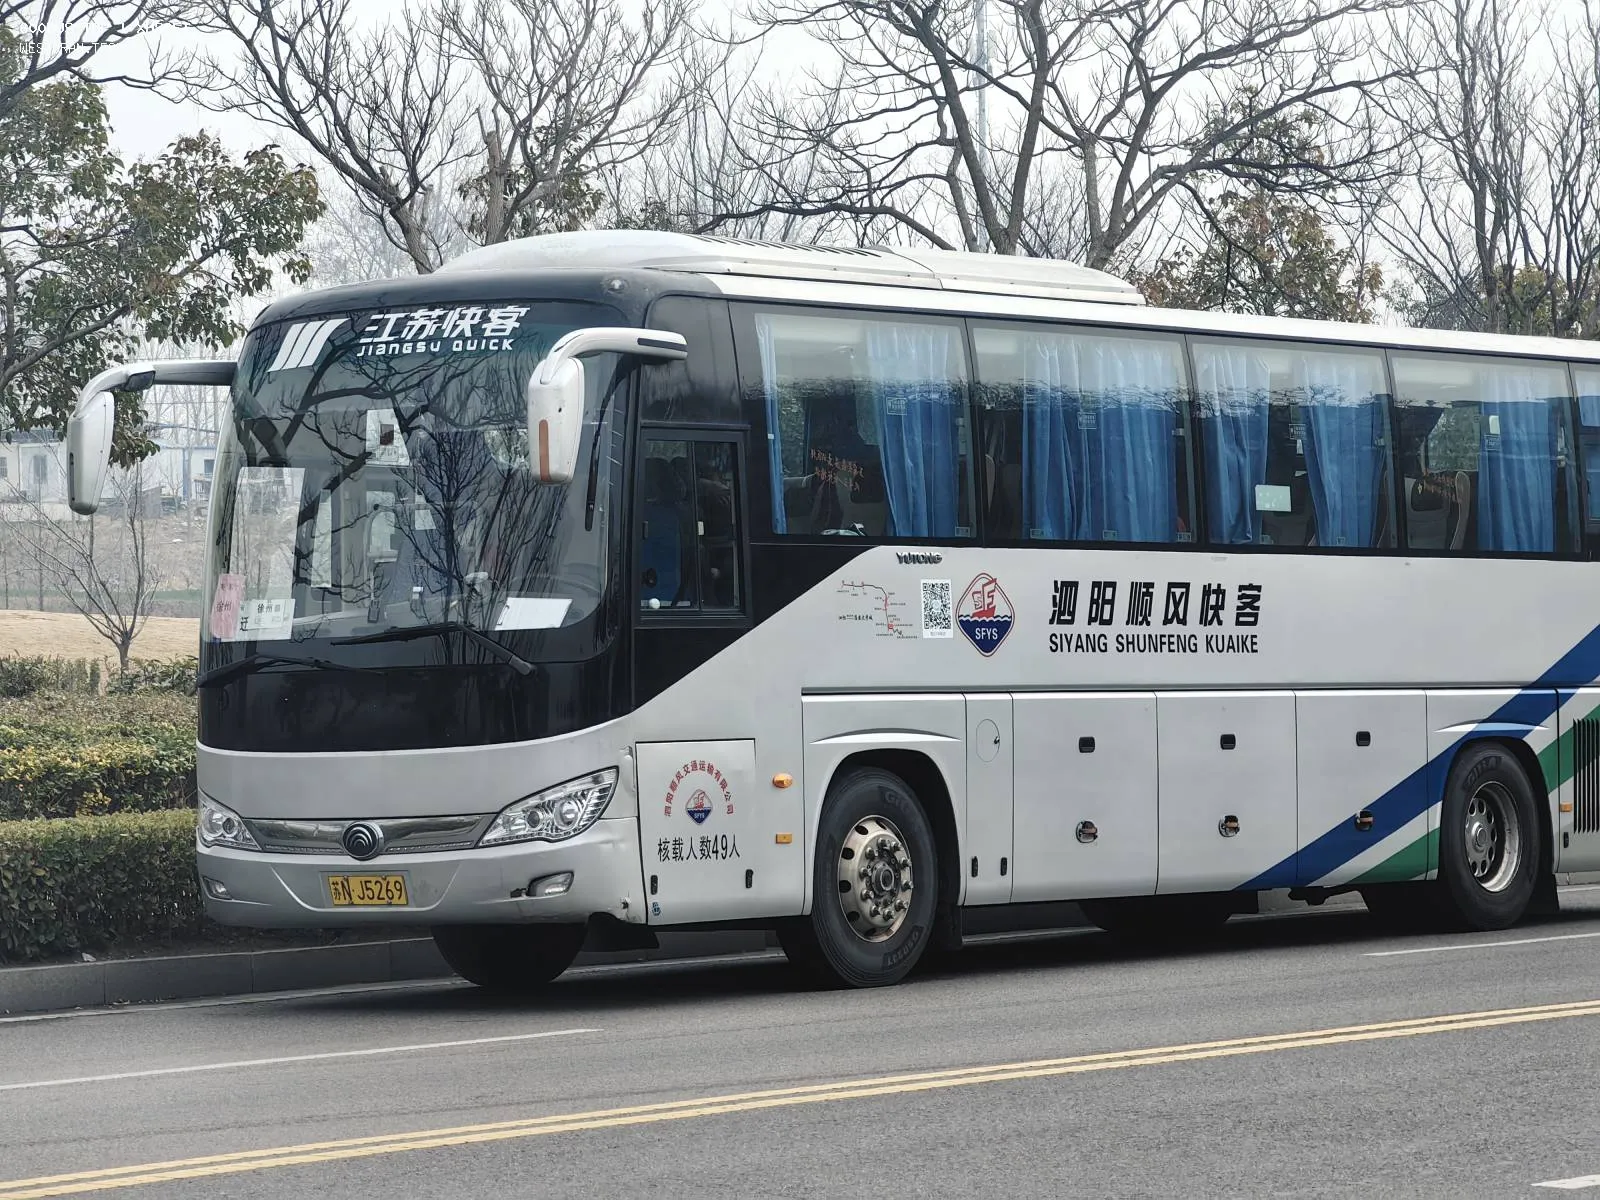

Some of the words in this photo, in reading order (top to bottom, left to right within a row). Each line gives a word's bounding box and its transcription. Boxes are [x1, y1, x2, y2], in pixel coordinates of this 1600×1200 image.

[359, 305, 531, 344] 江苏快客
[452, 338, 515, 352] QUICK
[896, 551, 943, 565] YUTONG
[1049, 579, 1263, 627] 泗阳顺风快客
[975, 627, 998, 641] SFYS
[1049, 633, 1108, 653] SIYANG
[1115, 634, 1198, 653] SHUNFENG
[1205, 634, 1259, 654] KUAIKE
[664, 759, 735, 817] 泗阳顺风交通运输有限公司
[657, 833, 741, 862] 核载人数49人
